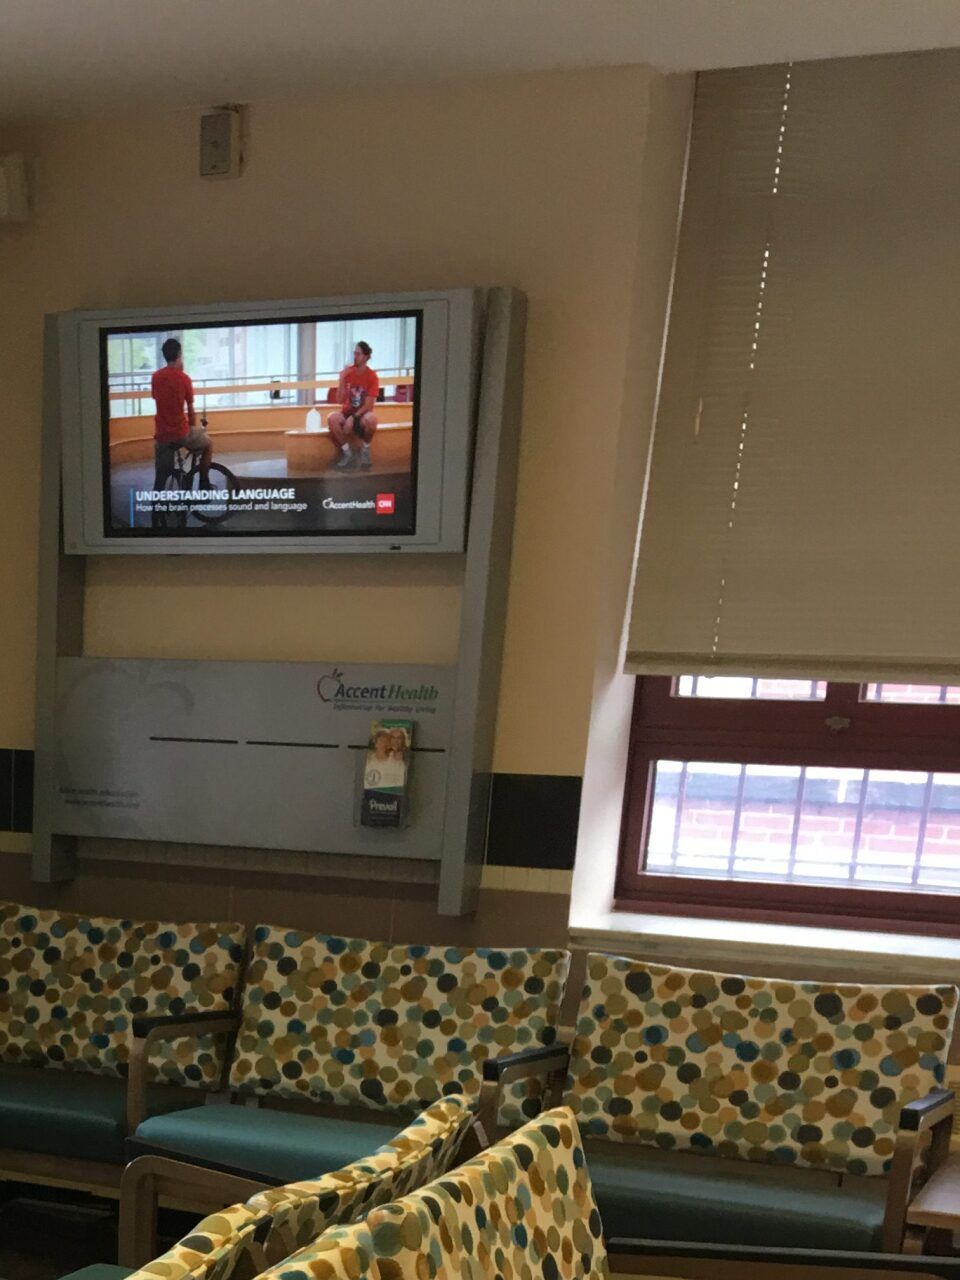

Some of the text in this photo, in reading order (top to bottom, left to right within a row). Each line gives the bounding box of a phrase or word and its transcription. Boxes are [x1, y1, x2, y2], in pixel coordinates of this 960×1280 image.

[135, 488, 296, 501] UNDERSTANDING LANGUAGE
[135, 500, 308, 513] How the brain processes sound and language
[334, 683, 440, 701] AccentHealth
